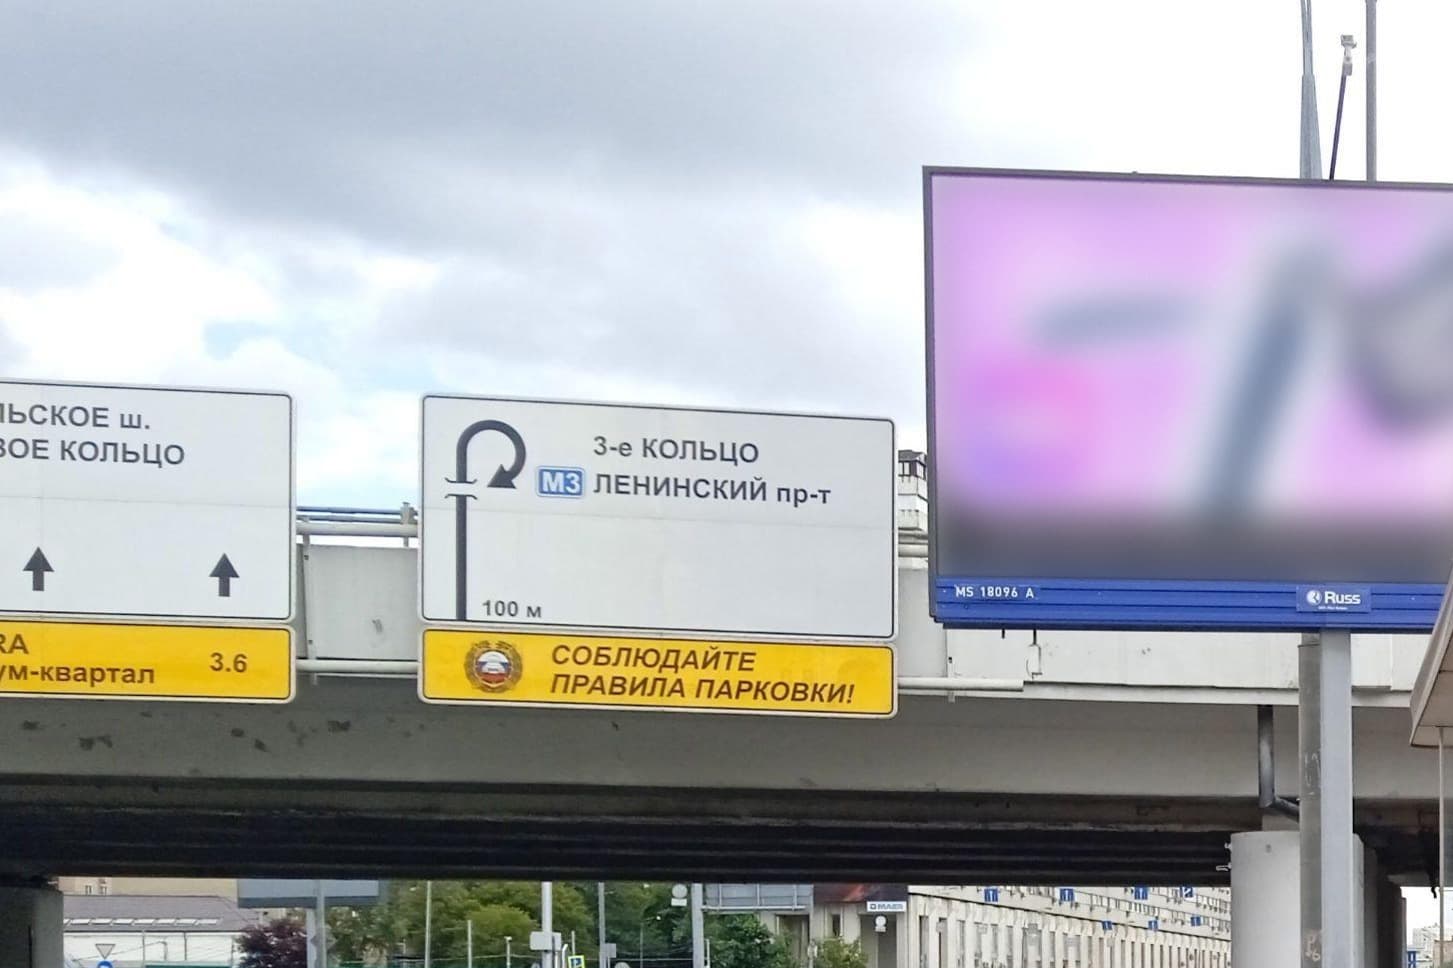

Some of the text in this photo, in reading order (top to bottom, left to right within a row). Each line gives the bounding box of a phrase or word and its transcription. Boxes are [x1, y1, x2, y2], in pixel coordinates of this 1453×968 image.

[0, 403, 150, 430] ЬСКОЕ ш.
[60, 440, 185, 469] КОЛЬЦО
[593, 436, 759, 465] 3-е КОЛЬЦО
[593, 473, 767, 501] ЛЕНИНСКИЙ
[777, 486, 831, 507] пр-т
[956, 586, 1035, 599] MS 18096 A
[1324, 590, 1361, 605] Russ
[482, 600, 542, 618] 100 м
[210, 652, 248, 673] 3.6
[551, 643, 757, 673] СОБЛЮДАЙТЕ
[551, 674, 855, 704] ПРАВИЛА ПАРКОВКИ!
